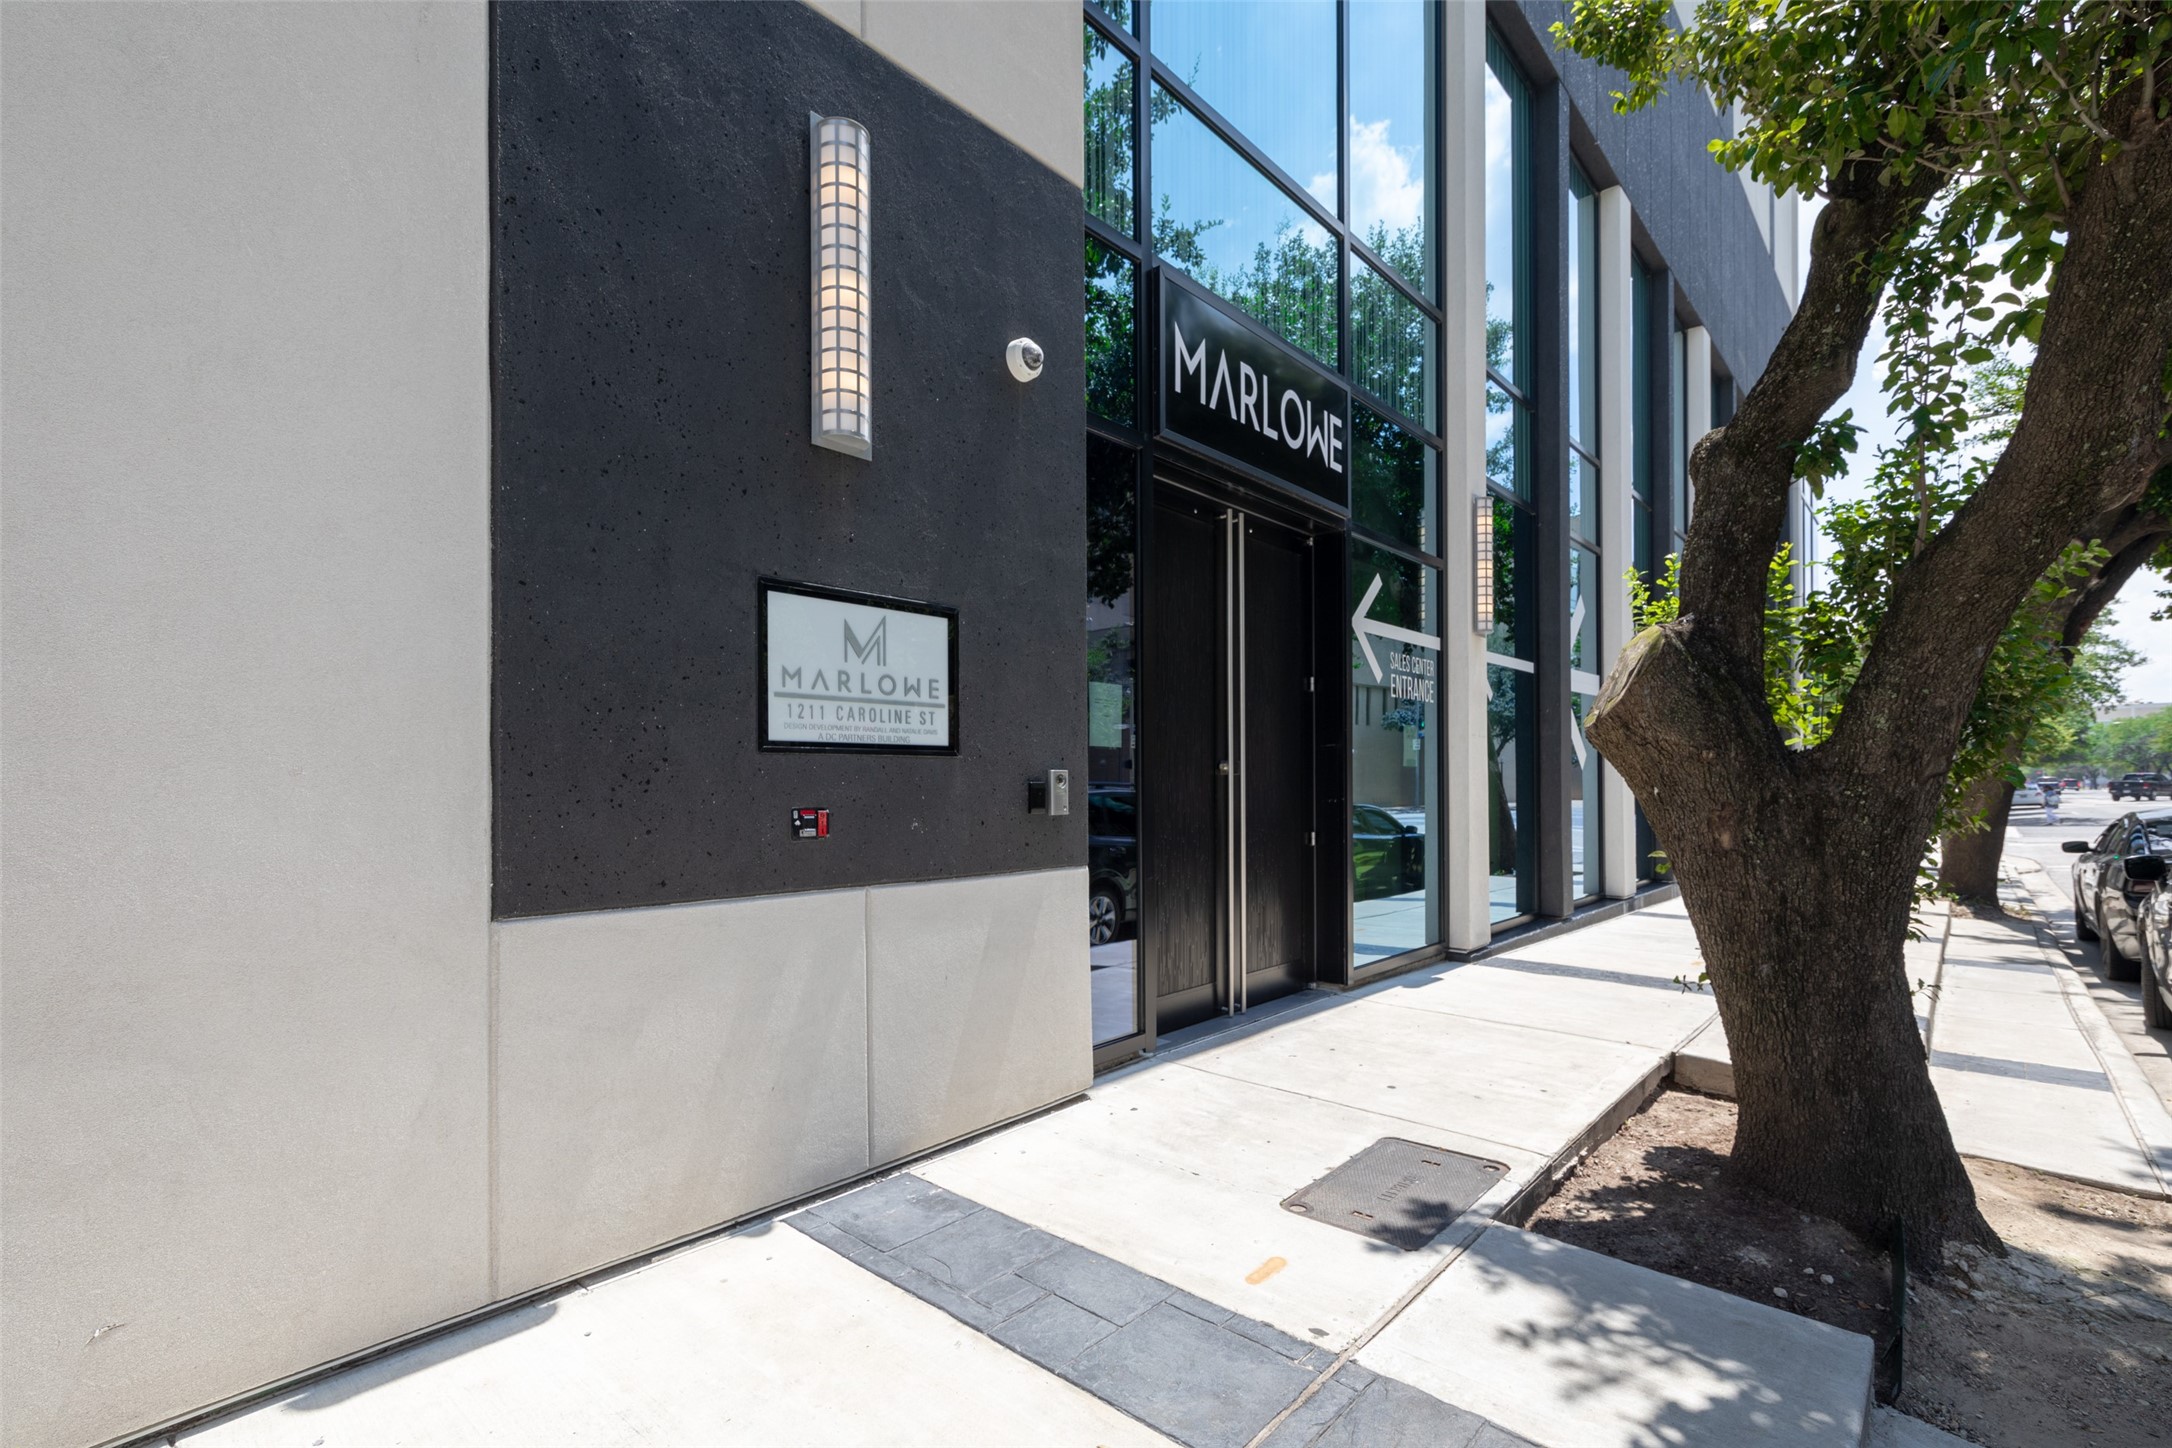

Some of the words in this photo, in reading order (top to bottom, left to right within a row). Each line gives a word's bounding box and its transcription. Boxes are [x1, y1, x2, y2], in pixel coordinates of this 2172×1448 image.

[1174, 320, 1343, 474] MARLOWE
[1390, 651, 1411, 672] SALES
[1411, 656, 1435, 677] CENTER
[781, 664, 940, 700] MARLOWE
[1390, 673, 1435, 703] ENTRANCE
[787, 703, 825, 721] 1211
[836, 705, 912, 725] CAROLINE
[919, 710, 936, 726] ST
[783, 722, 807, 730] DESIGN
[808, 723, 853, 733] DEVELOPMENT
[854, 725, 862, 733] BY
[862, 725, 887, 734] RANDALL
[888, 727, 900, 735] AND
[817, 732, 824, 741] A
[825, 732, 838, 741] DC
[838, 733, 877, 743] PARTNERS
[877, 734, 912, 744] BUILDING
